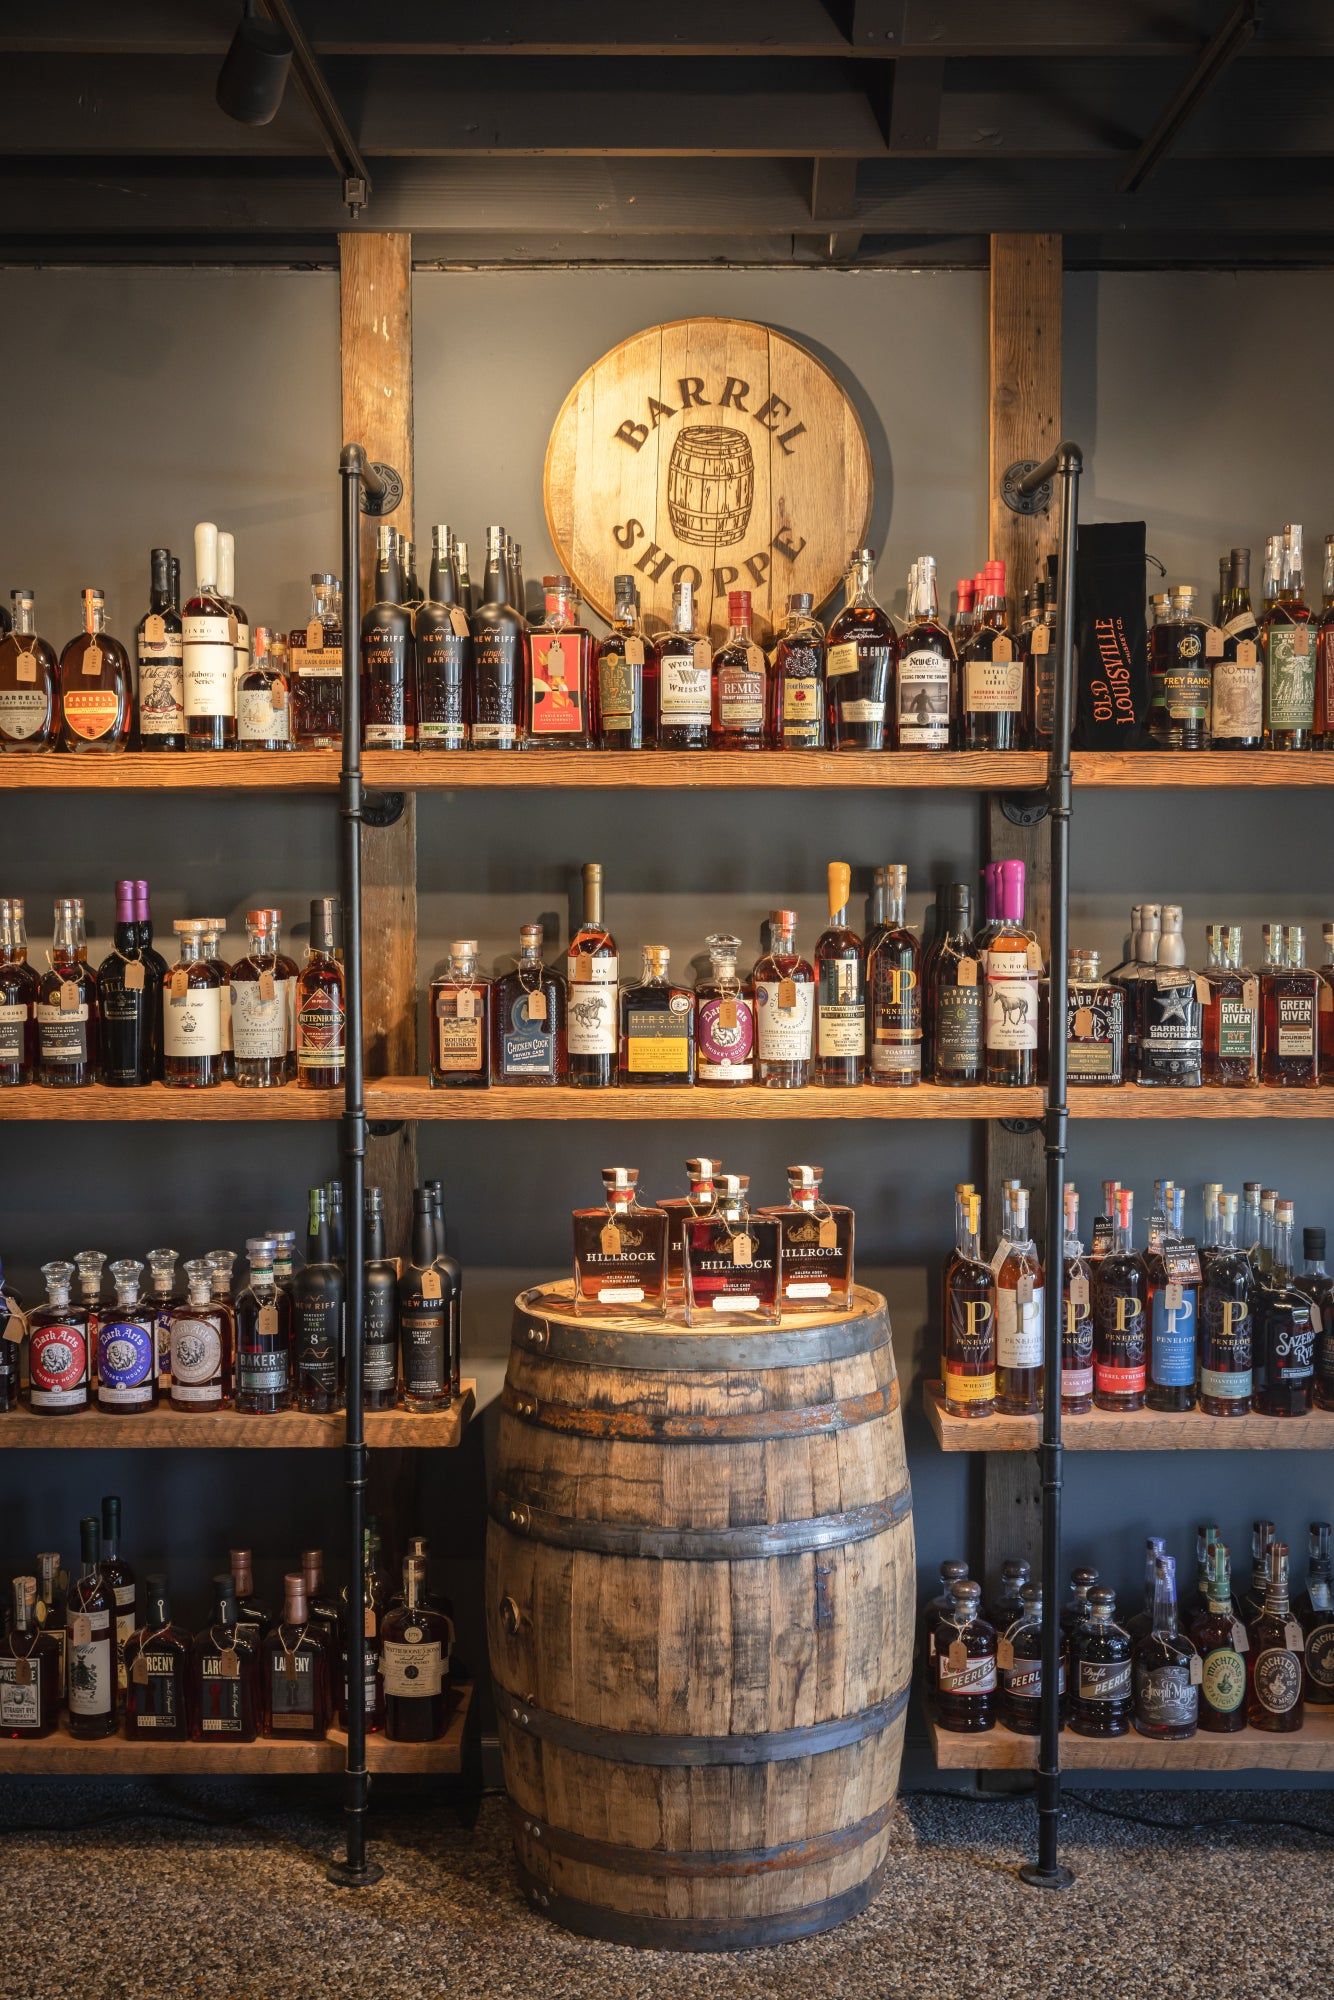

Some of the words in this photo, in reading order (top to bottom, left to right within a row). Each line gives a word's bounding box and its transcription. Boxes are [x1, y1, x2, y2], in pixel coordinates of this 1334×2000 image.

[614, 376, 807, 456] BARREL
[613, 518, 806, 598] SHOPPE
[383, 635, 404, 643] RIFF
[445, 635, 464, 643] RIFF
[494, 635, 516, 643] RIFF
[870, 646, 890, 658] ENVY
[367, 657, 400, 665] BARREL
[427, 656, 461, 664] BARREL
[477, 657, 512, 665] BARREL
[909, 657, 925, 667] New
[925, 657, 939, 666] Era
[1096, 618, 1136, 726] LOUISVILLE
[194, 678, 215, 686] Series
[1164, 677, 1185, 686] FREY
[1187, 677, 1211, 686] RANCH
[1232, 675, 1254, 684] MILL
[669, 683, 707, 693] WHISKEY
[724, 682, 760, 694] REMUS
[1090, 680, 1113, 722] OLD
[888, 969, 917, 1005] P
[1222, 1003, 1252, 1013] GREEN
[1280, 1000, 1311, 1011] GREEN
[632, 1015, 685, 1024] HIRSCH
[702, 1005, 721, 1022] Dar
[1222, 1013, 1251, 1024] RIVER
[1281, 1011, 1311, 1021] RIVER
[1227, 1032, 1245, 1040] RYE
[507, 1041, 532, 1054] CHICKEN
[533, 1039, 549, 1050] COCK
[705, 1041, 729, 1057] WHISKEY
[731, 1042, 747, 1056] HOUSE
[586, 1252, 656, 1263] HILLROCK
[314, 1301, 336, 1311] RIFF
[423, 1299, 444, 1308] RIFF
[963, 1301, 992, 1336] P
[1114, 1297, 1142, 1332] P
[1166, 1300, 1193, 1334] P
[1219, 1301, 1249, 1336] P
[33, 1330, 57, 1349] Dark
[57, 1330, 79, 1349] Arts
[99, 1327, 120, 1345] Dark
[122, 1328, 144, 1347] Arts
[310, 1334, 319, 1345] 8
[240, 1352, 287, 1367] BAKER'S
[1293, 1344, 1314, 1367] RYE
[36, 1369, 60, 1385] WHISKEY
[61, 1367, 79, 1383] HOUSE
[101, 1365, 123, 1381] WHISKEY
[125, 1365, 144, 1381] HOUSE
[147, 1656, 174, 1672] RCENY
[274, 1656, 310, 1672] LAENY
[1011, 1671, 1041, 1687] PEERL
[1206, 1684, 1235, 1705] STRAIGHT
[1263, 1687, 1277, 1705] SOUR
